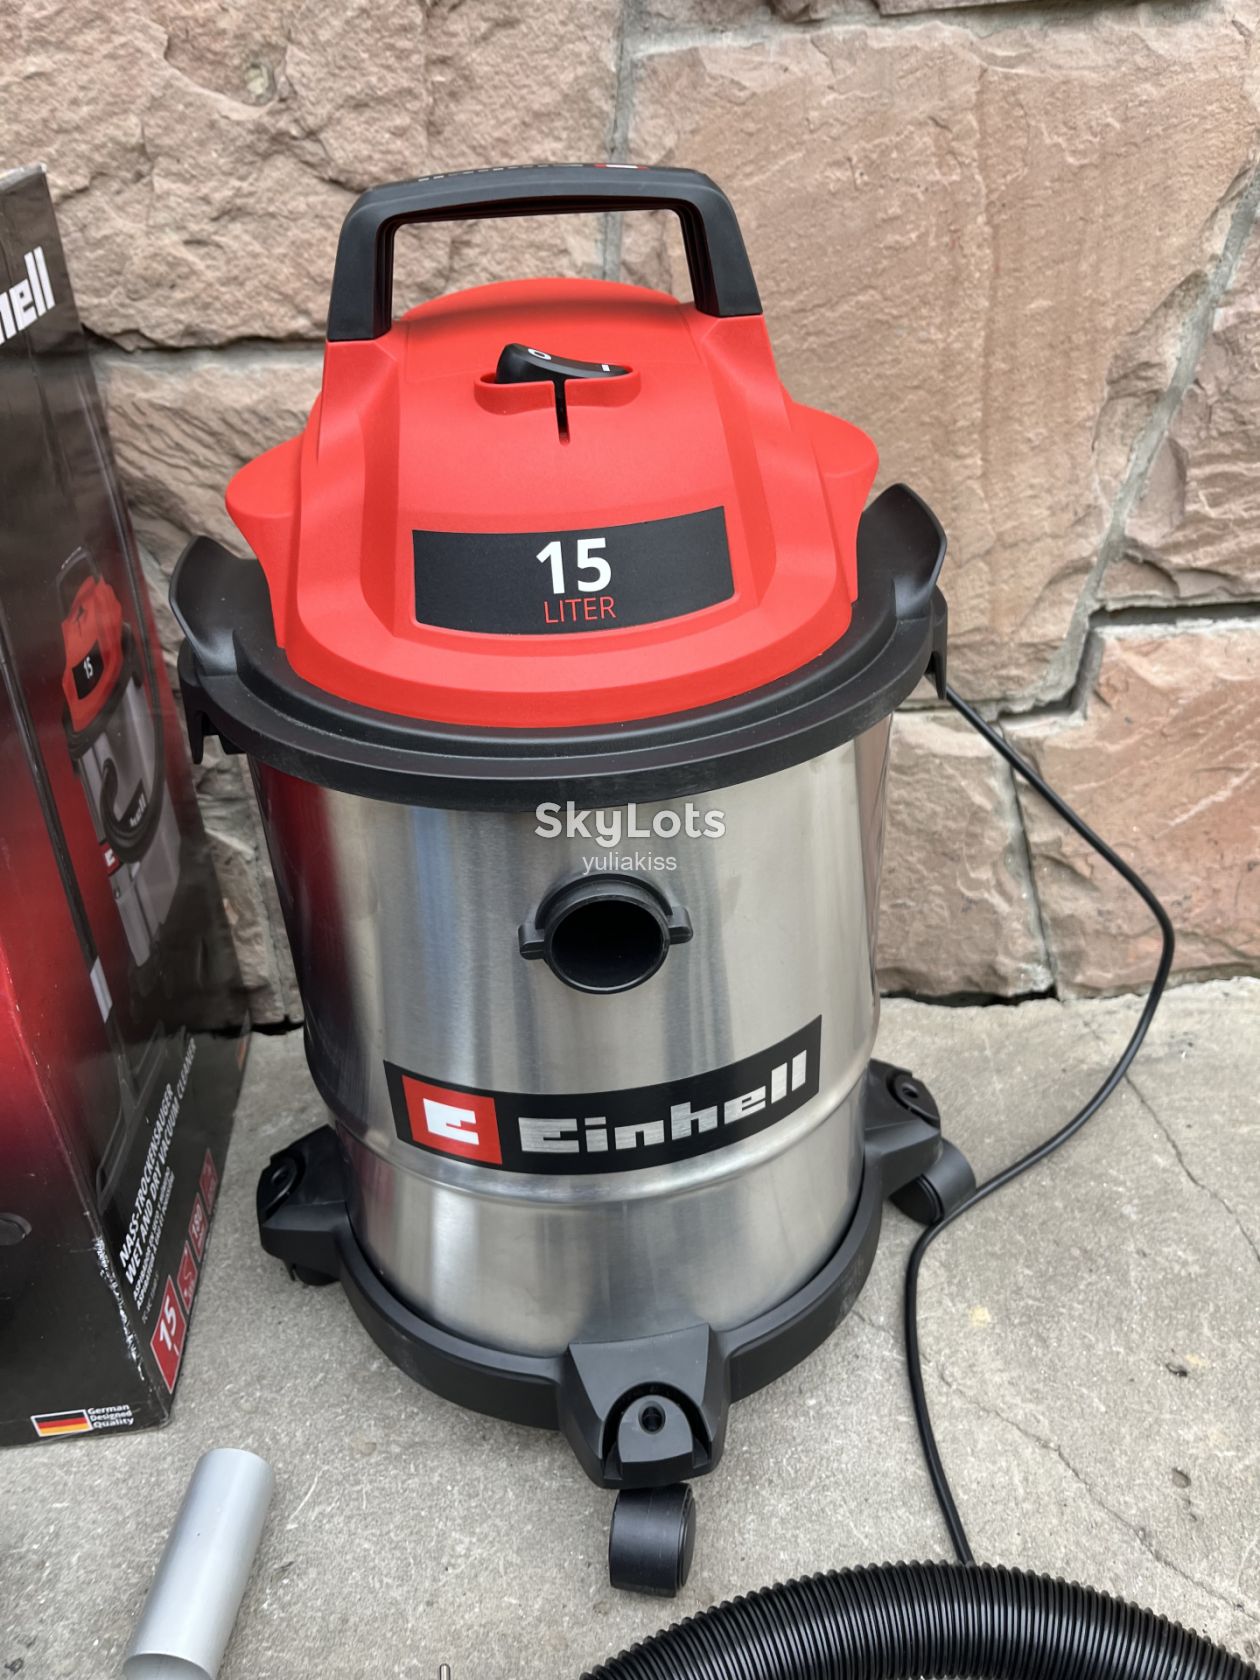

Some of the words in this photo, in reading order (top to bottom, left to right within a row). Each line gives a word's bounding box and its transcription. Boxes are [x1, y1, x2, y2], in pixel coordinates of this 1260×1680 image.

[536, 537, 612, 594] 15
[544, 596, 617, 624] LITER
[518, 1050, 807, 1153] Einhell
[119, 1083, 174, 1268] NASS-TROCKENSAUGER
[125, 1238, 143, 1284] WET
[140, 1198, 153, 1243] AND
[149, 1161, 162, 1201] DRY
[158, 1096, 180, 1165] VACUUM
[177, 1037, 196, 1099] CLEANER
[159, 1294, 178, 1351] 15
[88, 1404, 130, 1416] German
[90, 1410, 133, 1423] Designed
[93, 1416, 135, 1429] Quality
